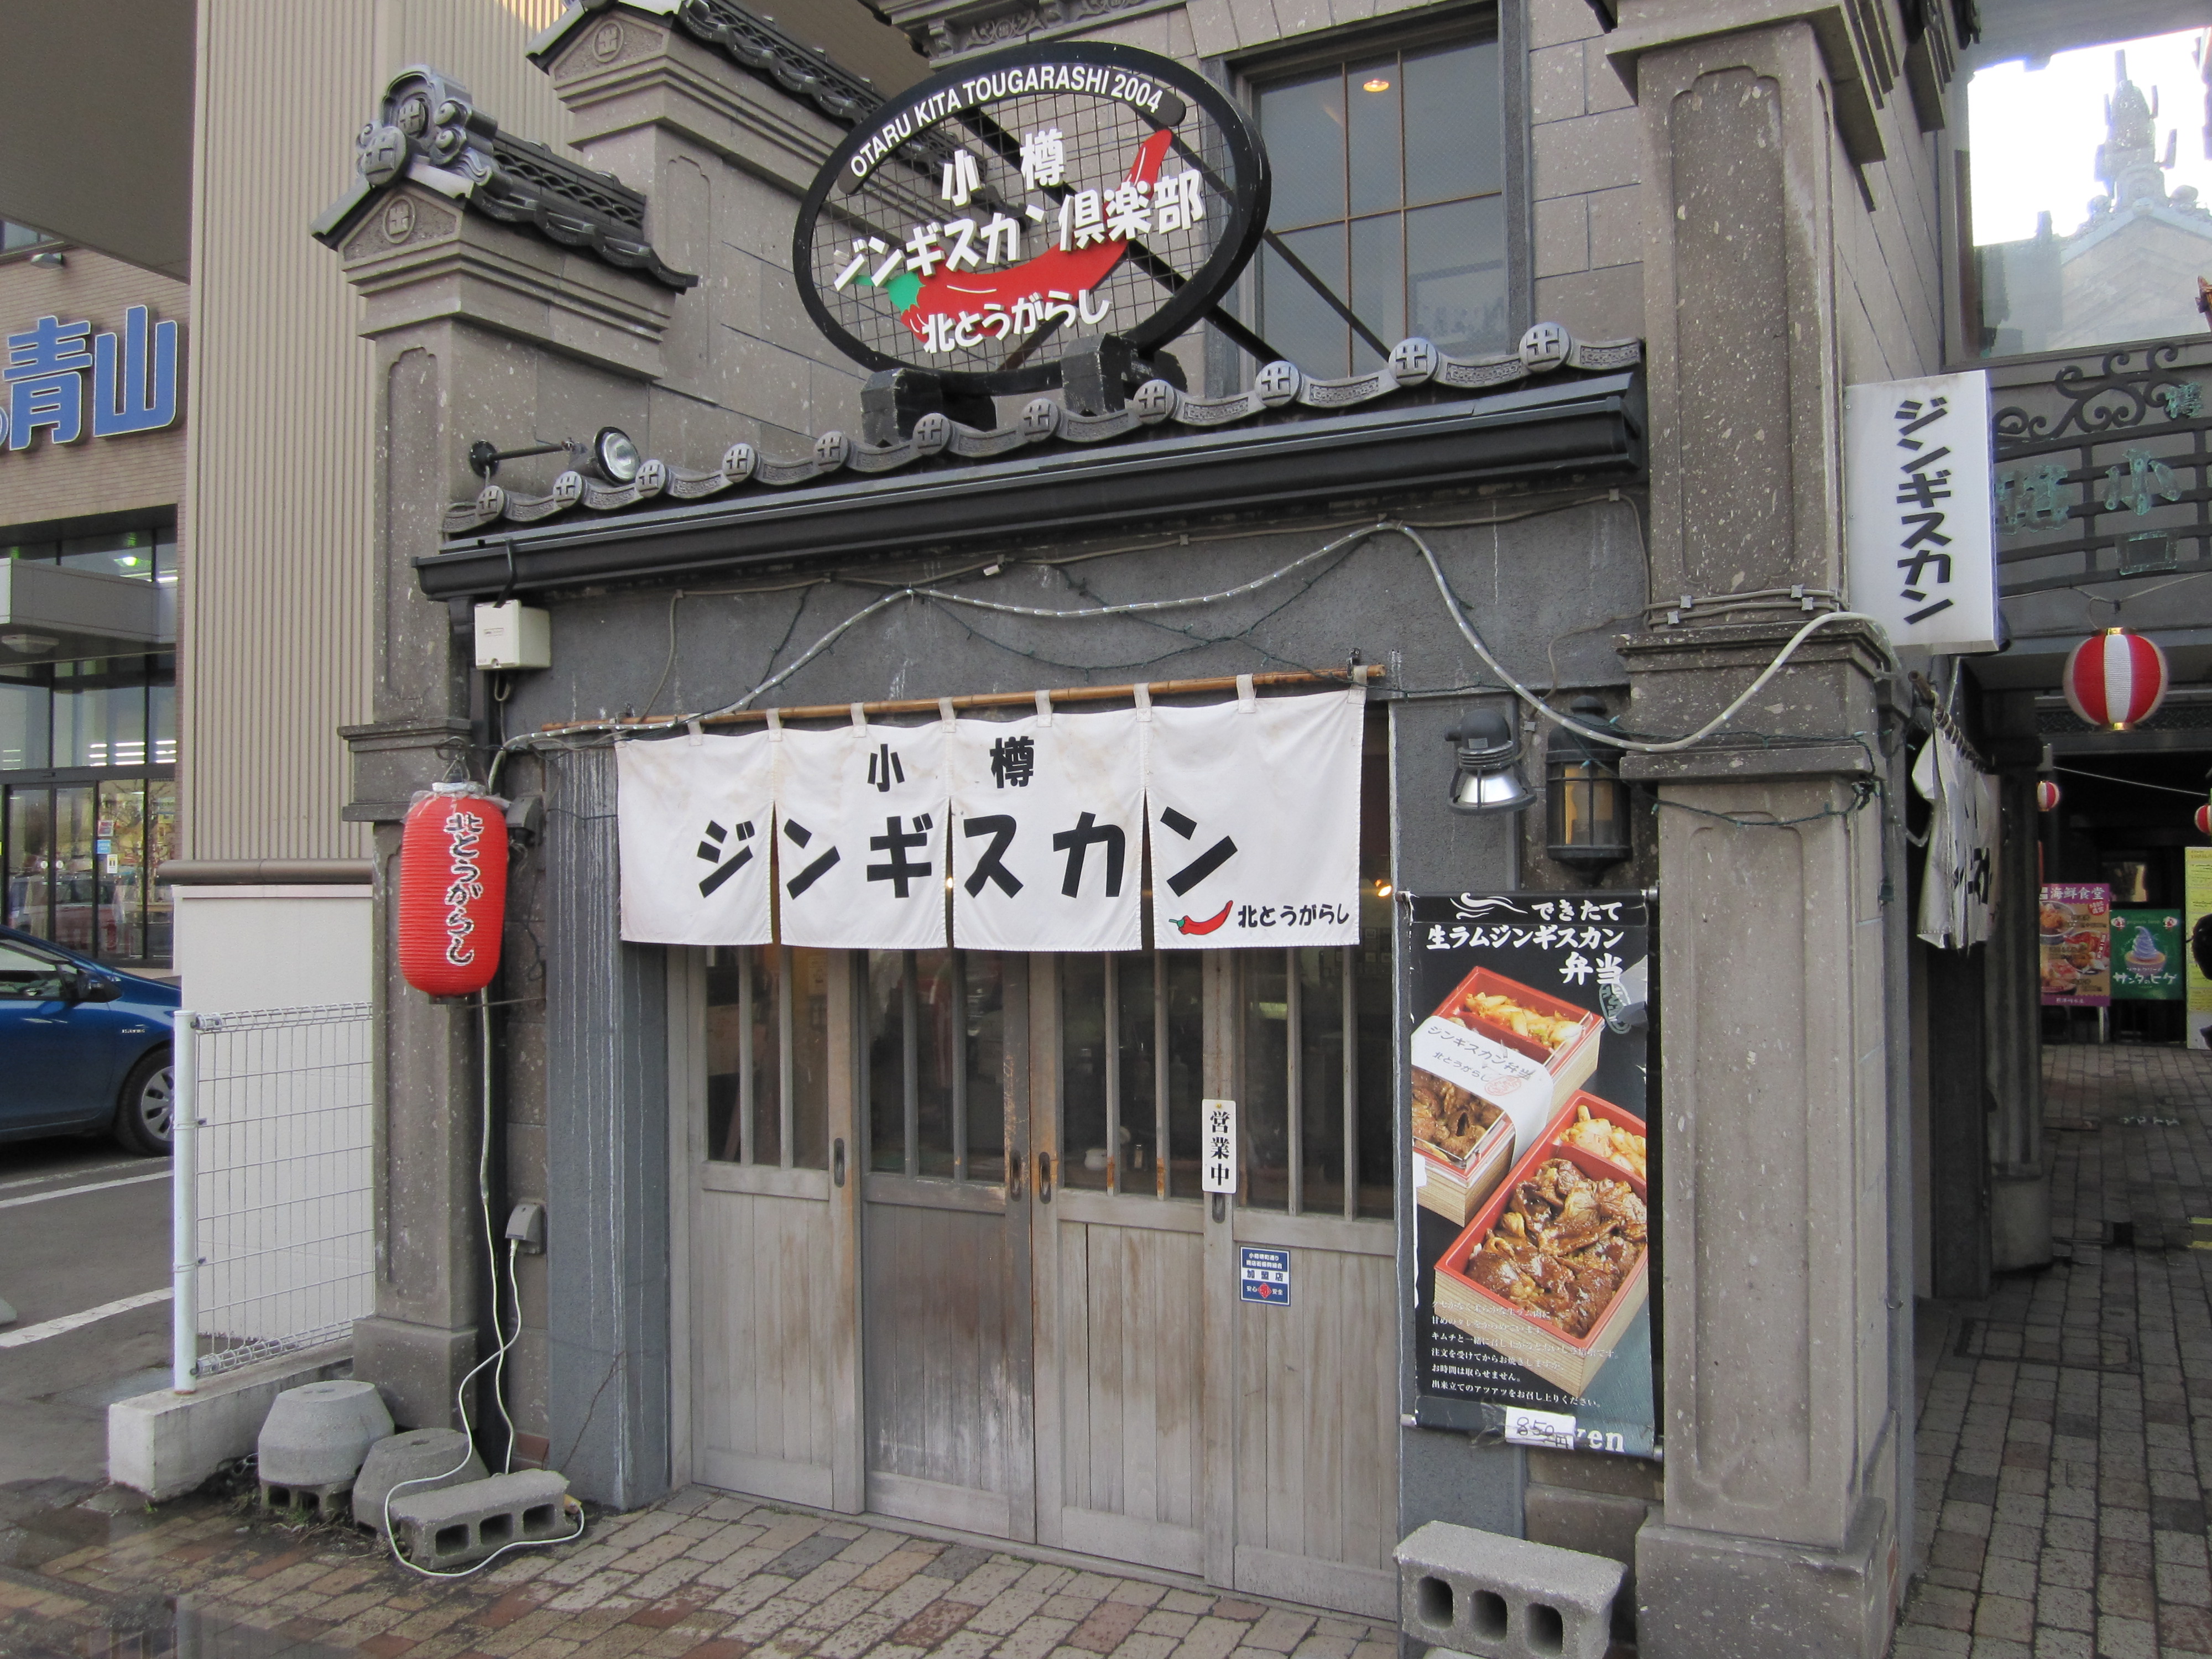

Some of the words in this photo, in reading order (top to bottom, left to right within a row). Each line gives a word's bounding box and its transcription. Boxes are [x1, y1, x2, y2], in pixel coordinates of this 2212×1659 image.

[851, 114, 912, 178] OTARU
[917, 87, 962, 128] KITA
[963, 65, 1108, 105] TOUGARASHI
[1111, 72, 1164, 113] 2004
[942, 127, 1066, 206] 小樽
[921, 289, 1112, 355] 北とうがらし
[0, 305, 178, 451] 青山
[1894, 396, 1954, 625] ジンギスカン
[867, 736, 1035, 792] 小樽
[697, 805, 1238, 900] ジンギスカン
[444, 811, 484, 966] 北とうがらし
[1238, 903, 1349, 928] 北とうがらし
[1531, 899, 1623, 921] できたて
[2050, 887, 2105, 900] 海鮮食堂
[1426, 924, 1624, 951] 生ラムジンギスカン
[1558, 952, 1623, 985] 弁当
[1428, 1026, 1534, 1079] ジンギスカン弁当
[1432, 1052, 1490, 1082] 北とうがらし
[1210, 1110, 1230, 1186] 営業中
[1247, 1269, 1283, 1282] 加盟店
